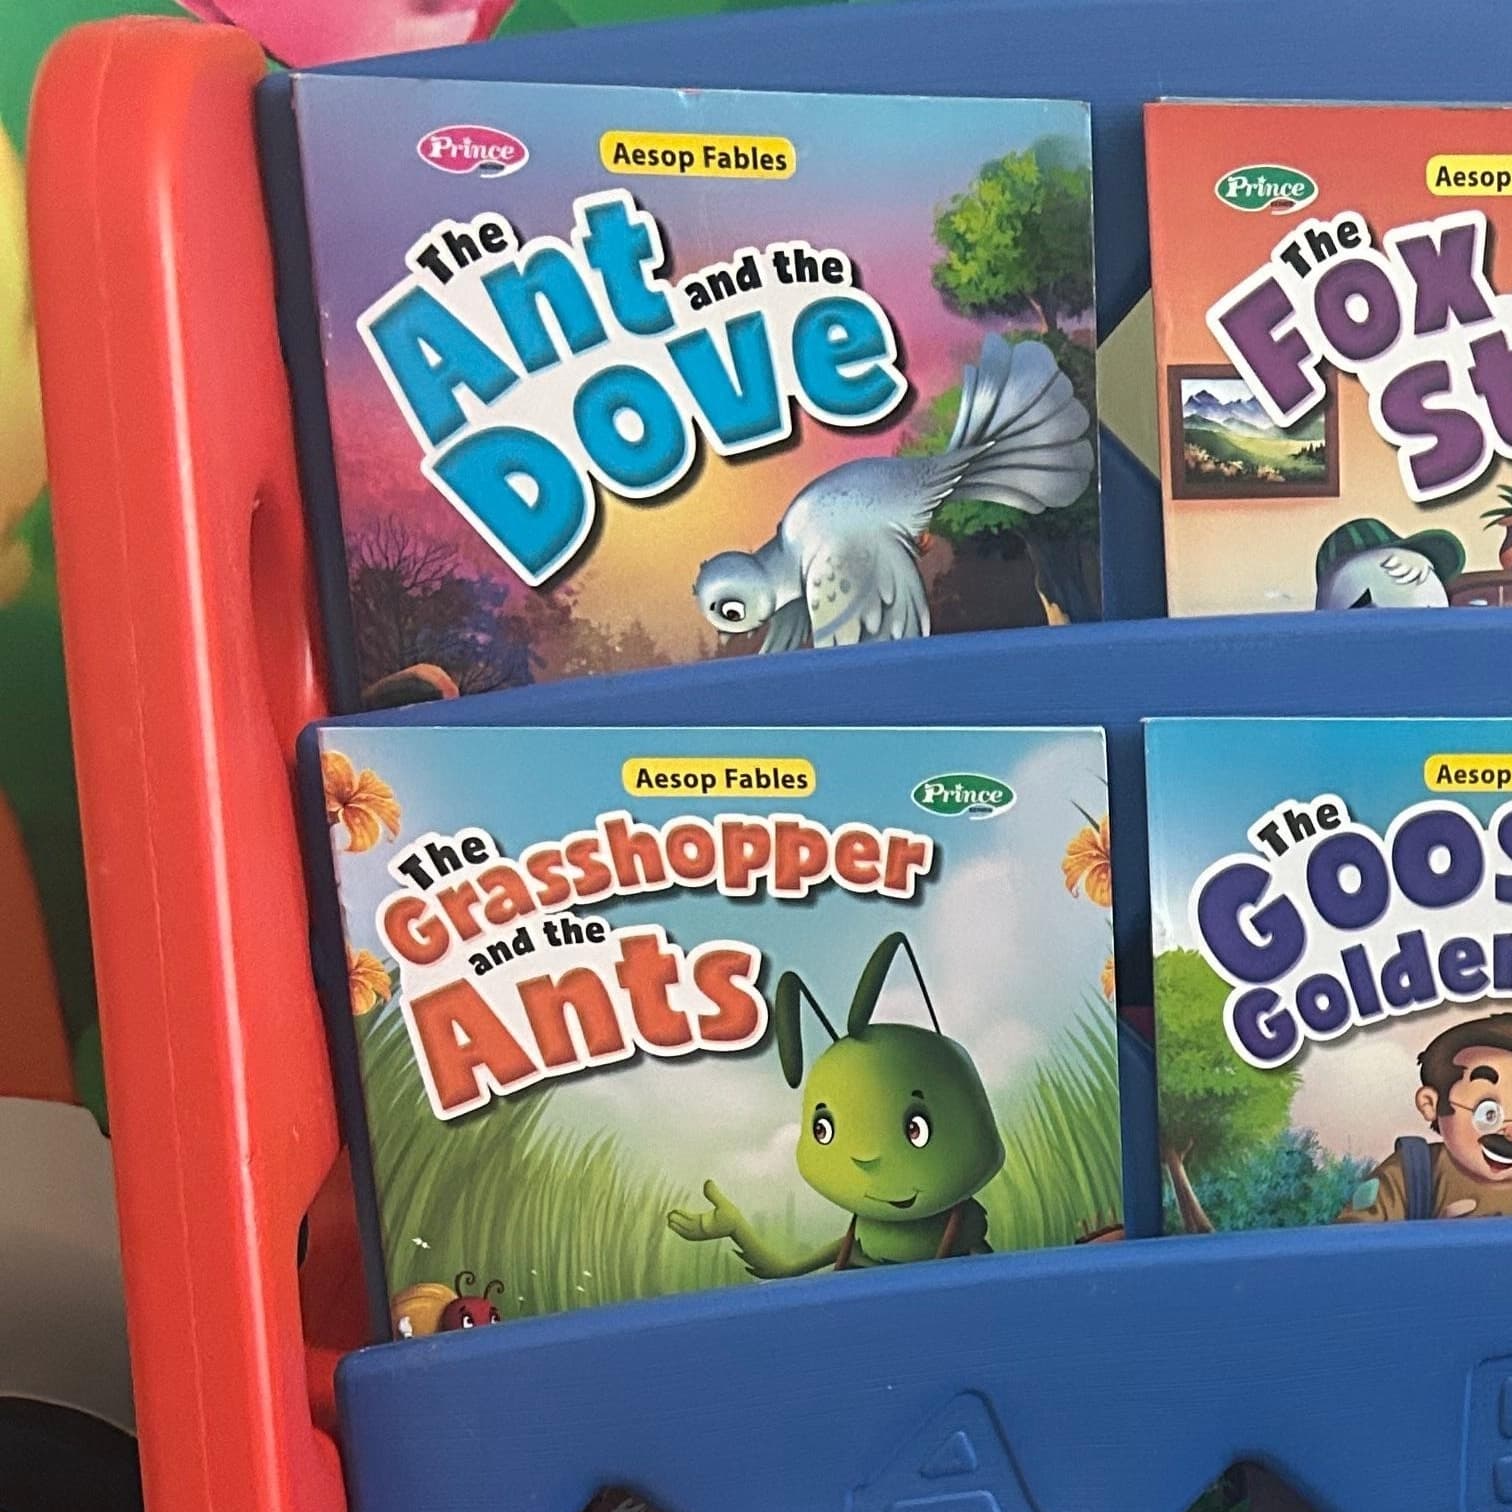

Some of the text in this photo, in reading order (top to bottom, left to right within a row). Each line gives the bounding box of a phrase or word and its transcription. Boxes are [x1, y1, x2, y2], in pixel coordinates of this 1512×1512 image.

[428, 135, 516, 160] Prince
[613, 142, 787, 173] Aesop Fables
[1225, 175, 1305, 198] Prince
[1435, 165, 1512, 191] Aesop
[416, 221, 508, 285] The
[1281, 218, 1361, 277] The
[368, 198, 845, 446] Ant and the
[1218, 223, 1492, 414] Fox
[432, 295, 900, 578] Dove
[635, 766, 809, 793] Aesop Fables
[922, 783, 1003, 803] Prince
[1436, 764, 1512, 789] Aesop
[1257, 803, 1341, 857] The
[398, 832, 490, 891] The
[382, 819, 932, 966] Grasshopper
[468, 917, 606, 976] and the
[409, 935, 762, 1112] Ants
